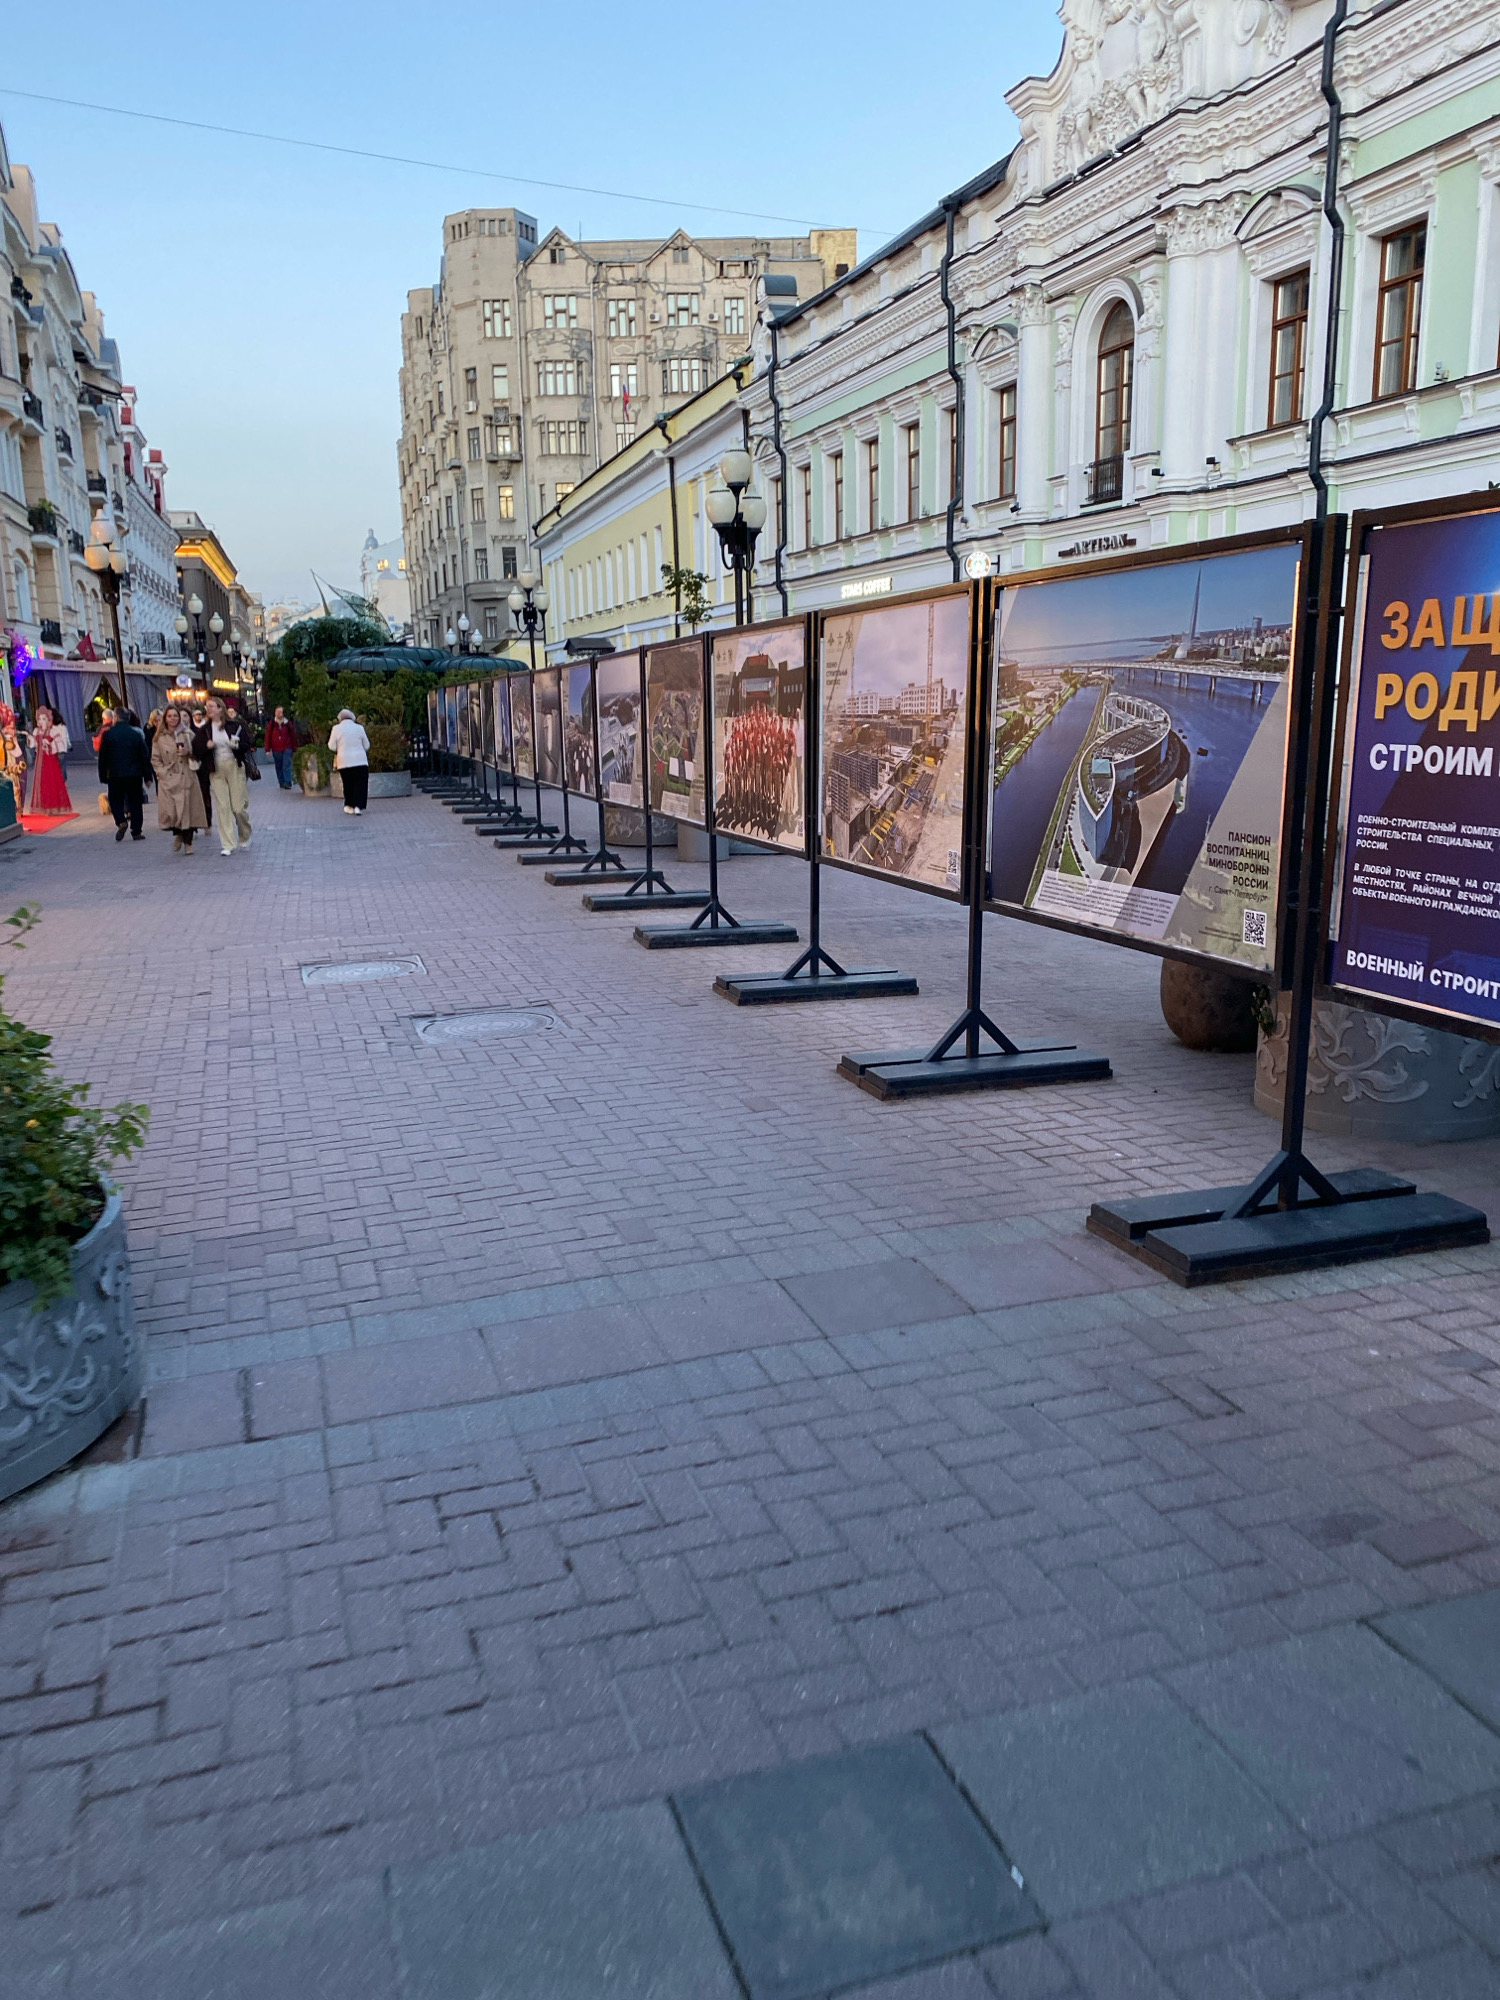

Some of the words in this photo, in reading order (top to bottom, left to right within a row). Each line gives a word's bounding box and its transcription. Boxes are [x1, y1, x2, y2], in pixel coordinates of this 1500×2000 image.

[1073, 533, 1128, 556] ARTISAN
[863, 576, 892, 596] COFFEE
[1381, 593, 1500, 655] ЗАЩ
[1374, 670, 1500, 732] РОДИ
[1369, 743, 1494, 777] СТРОИМ
[1357, 814, 1457, 832] ВОЕННО-СТРОИТЕЛЬНЫЙ
[1228, 831, 1271, 846] ПАНСИОН
[1355, 839, 1389, 851] РОССИИ.
[1356, 827, 1422, 842] СТРОИТЕЛЬСТВА
[1427, 834, 1494, 852] СПЕЦИАЛЬНЫХ,
[1206, 843, 1270, 863] ВОСПИТАННИЦ
[1208, 857, 1269, 875] МИНОБОРОНЫ
[1354, 863, 1360, 871] В
[1362, 863, 1392, 876] ЛЮБОЙ
[1395, 868, 1422, 880] ТОЧКЕ
[1424, 872, 1461, 887] СТРАНЫ,
[1464, 878, 1478, 889] НА
[1232, 875, 1269, 890] РОССИИ
[1352, 875, 1407, 892] МЕСТНОСТЯХ,
[1412, 884, 1452, 898] РАЙОНАХ
[1457, 890, 1494, 904] ВЕЧНОЙ
[1214, 885, 1269, 904] Санкт-Петербург
[1352, 887, 1389, 900] ОБЪЕКТЫ
[1389, 892, 1432, 907] ВОЕННОГО
[1432, 900, 1439, 908] И
[1346, 950, 1425, 982] ВОЕННЫЙ
[1429, 968, 1500, 1000] СТРОИТ
